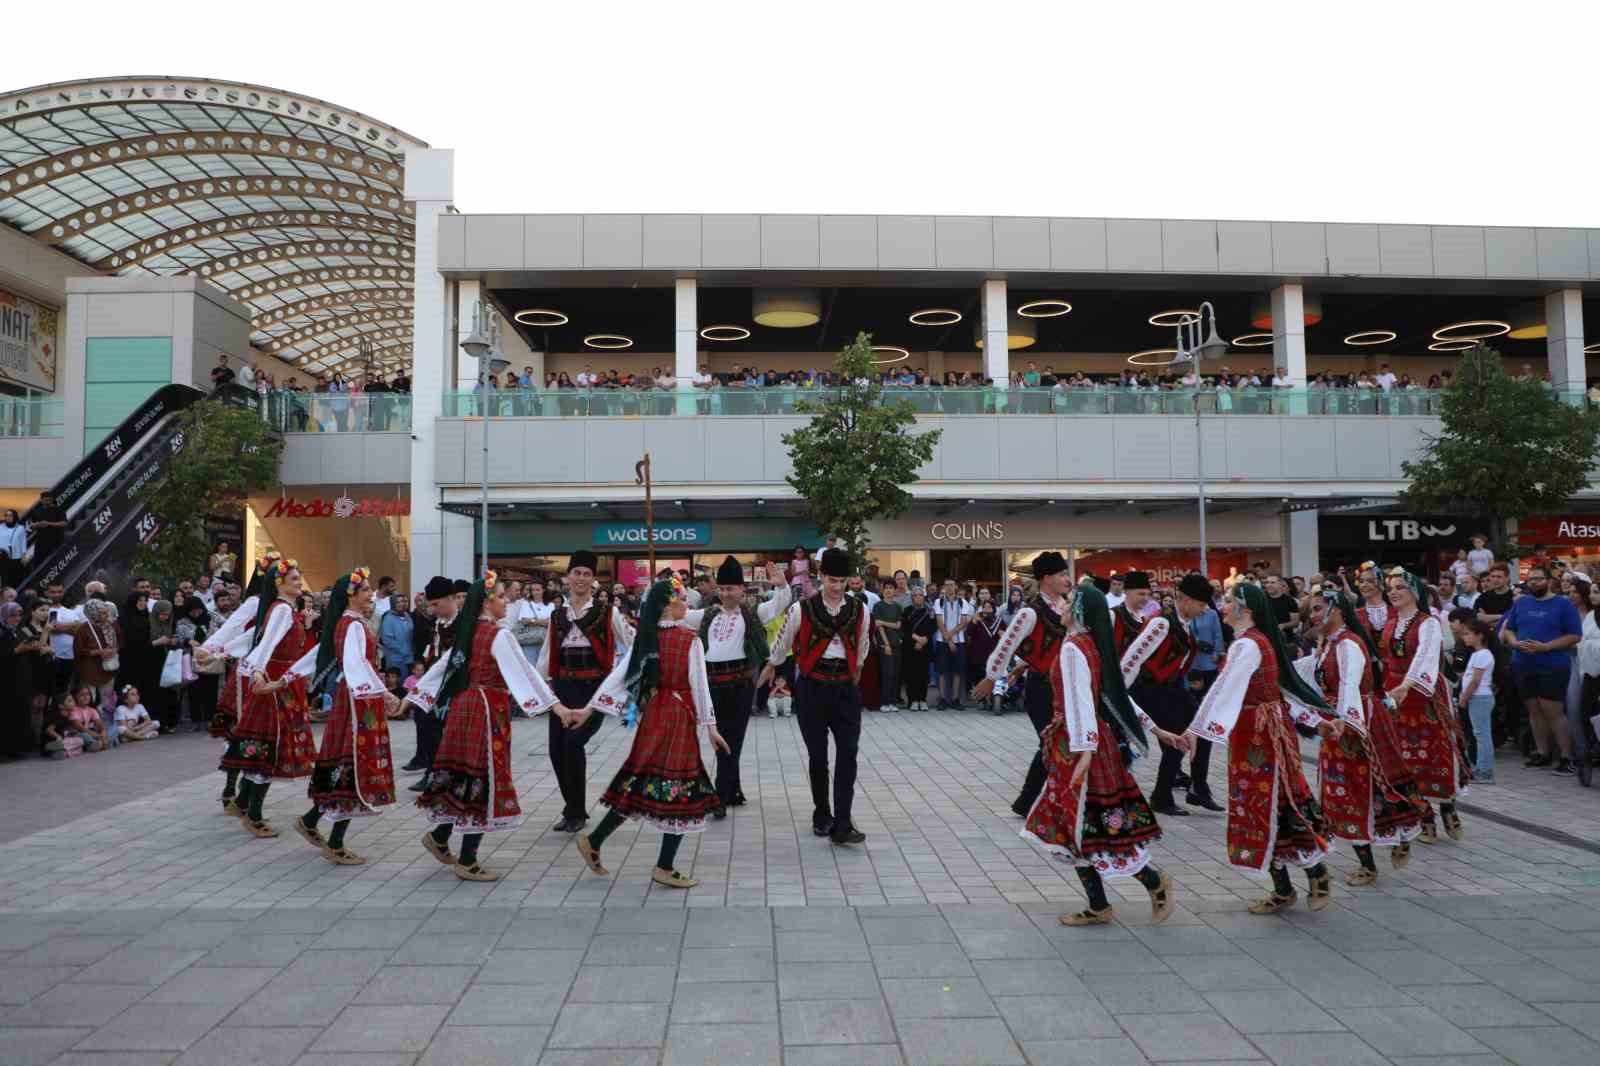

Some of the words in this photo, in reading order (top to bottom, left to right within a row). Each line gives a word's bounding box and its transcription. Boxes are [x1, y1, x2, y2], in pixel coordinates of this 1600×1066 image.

[93, 507, 112, 531] ZEN
[607, 527, 697, 542] watsons
[931, 520, 1004, 540] COLIN'S
[1368, 519, 1420, 541] LTB
